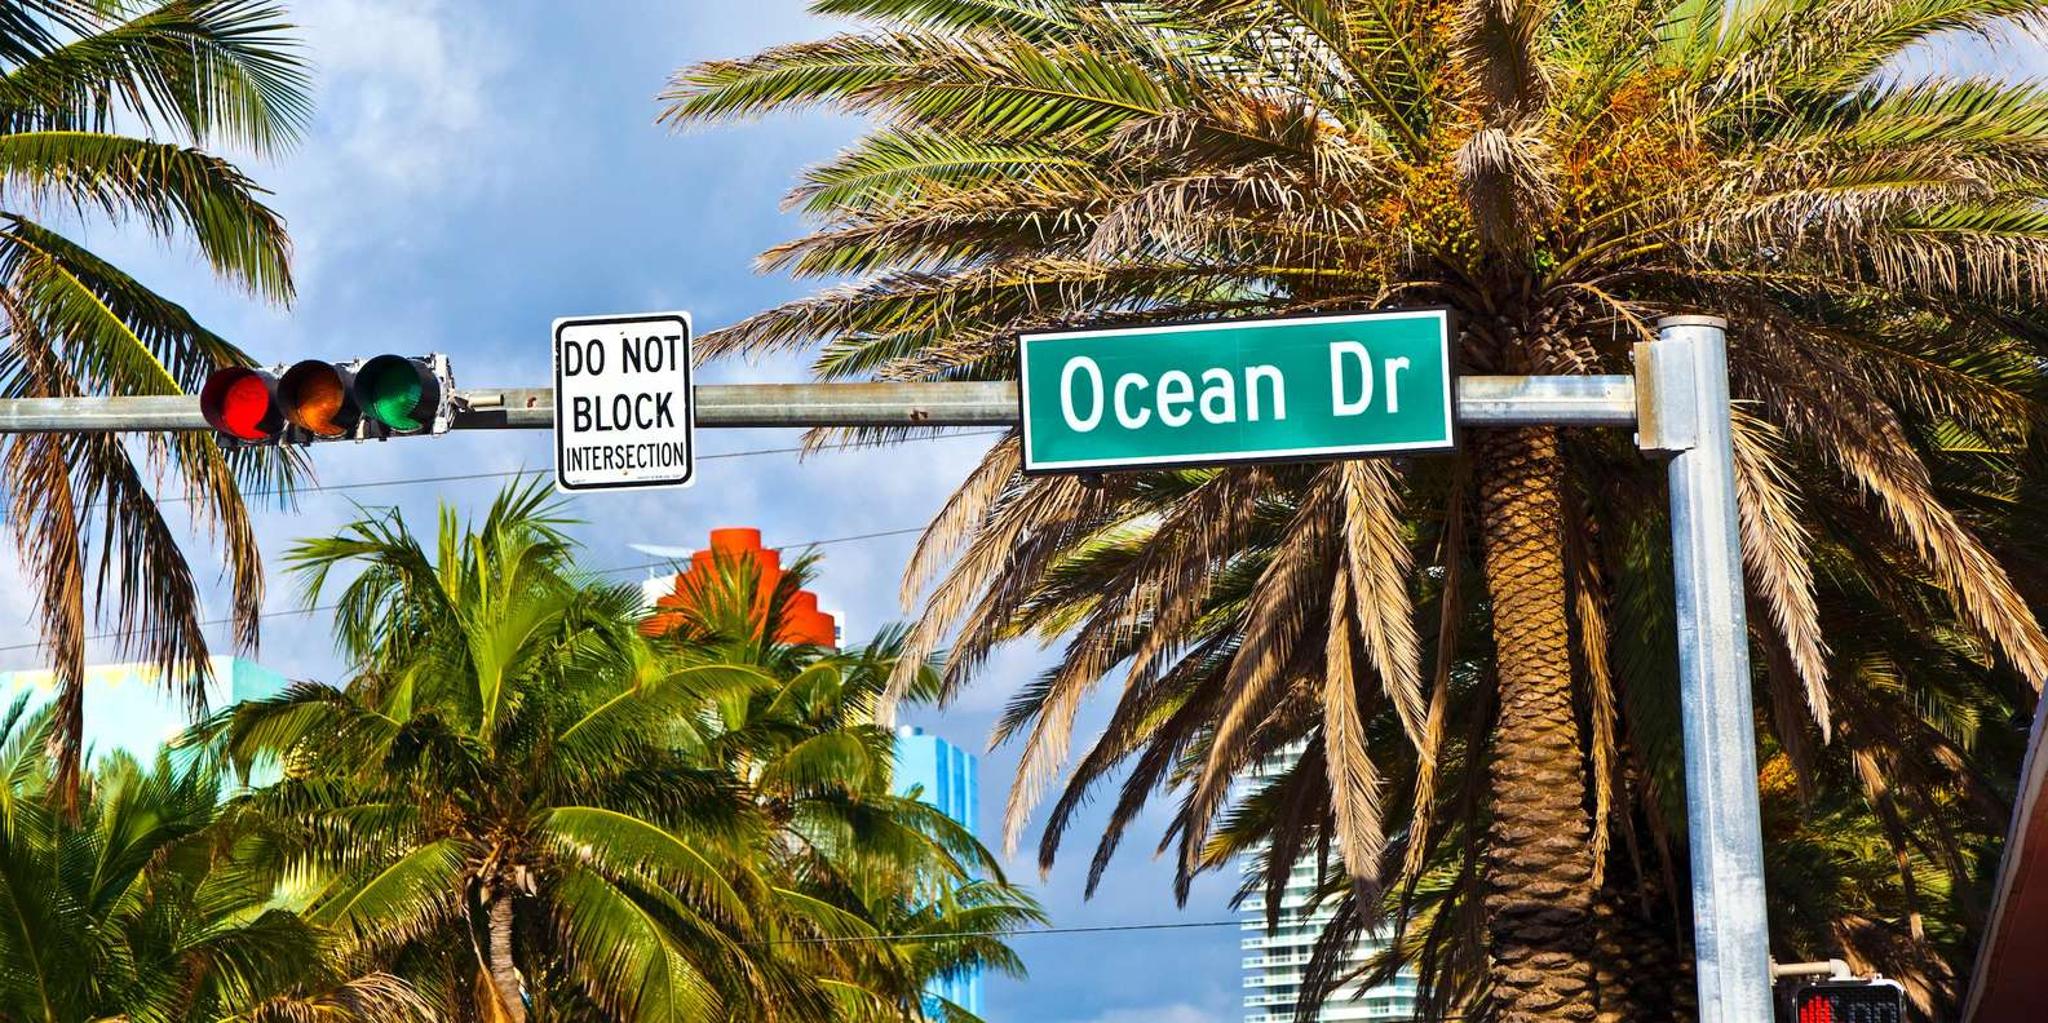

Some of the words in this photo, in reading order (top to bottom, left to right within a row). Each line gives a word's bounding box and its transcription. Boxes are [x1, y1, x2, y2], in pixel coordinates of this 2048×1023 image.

[565, 339, 605, 377] DO
[622, 335, 681, 373] NOT
[1059, 355, 1287, 433] Ocean
[1328, 340, 1411, 417] Dr
[573, 392, 675, 432] BLOCK
[567, 442, 685, 472] INTERSECTION
